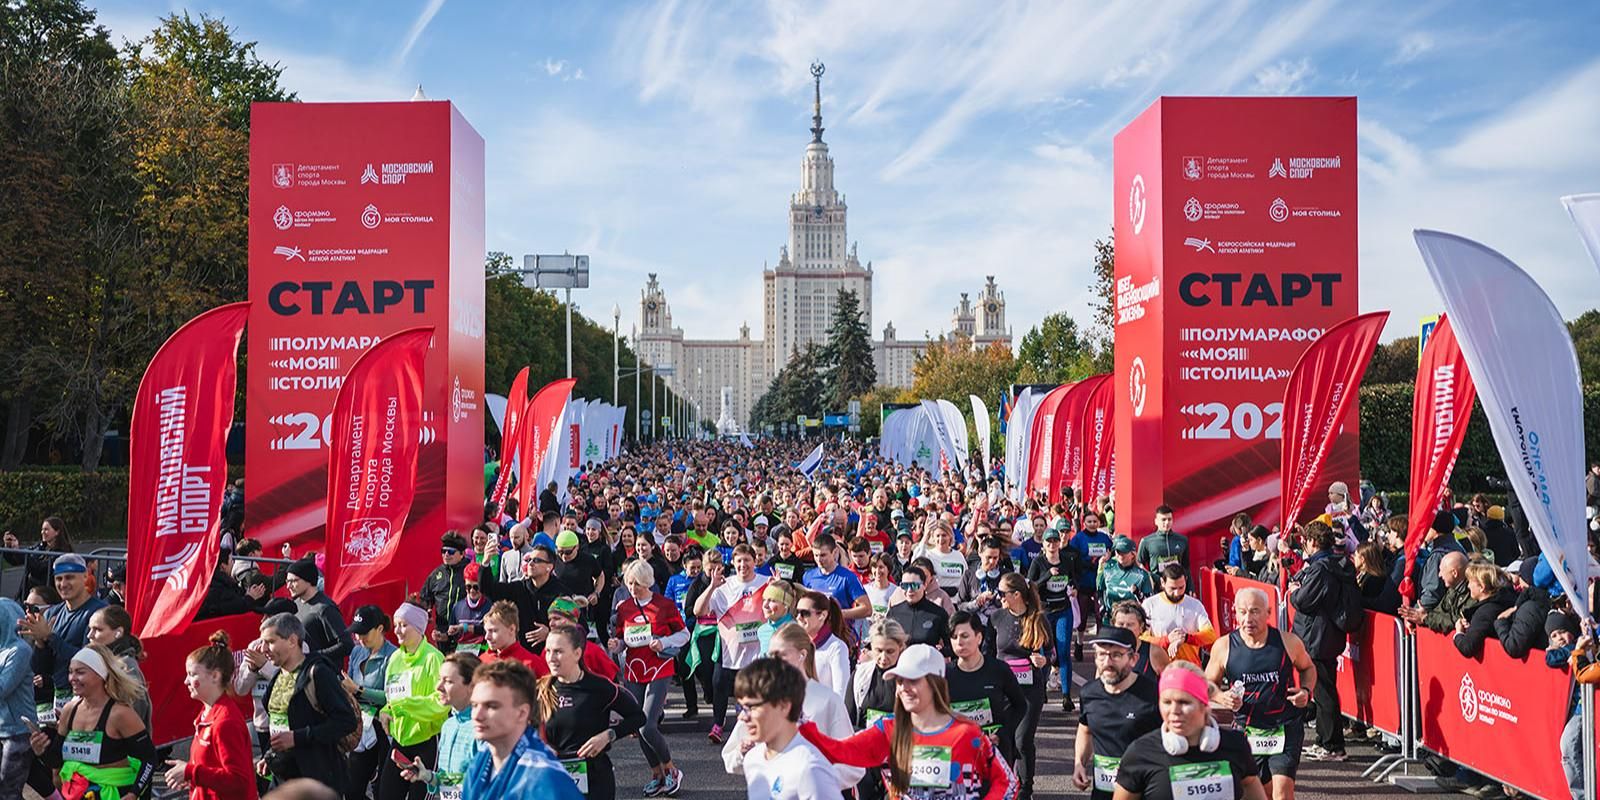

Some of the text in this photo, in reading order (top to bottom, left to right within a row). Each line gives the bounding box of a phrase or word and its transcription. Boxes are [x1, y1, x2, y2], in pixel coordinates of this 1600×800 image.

[381, 160, 434, 173] МОСКОВСКИЙ
[381, 173, 406, 184] СПОРТ
[1289, 156, 1341, 168] МОСКОВСКИЙ
[1289, 168, 1314, 178] СПОРТ
[268, 280, 435, 316] СТАРТ
[1179, 273, 1342, 307] СТАРТ
[1192, 402, 1284, 440] 202
[155, 385, 187, 538] МОСКОВСКИЙ
[346, 414, 364, 511] Департамент
[379, 396, 398, 508] города Москвы
[181, 463, 211, 534] СПОРТ
[365, 458, 378, 509] спорта
[71, 746, 91, 755] 51418
[1255, 740, 1278, 748] 51262
[1187, 782, 1223, 796] 51963
